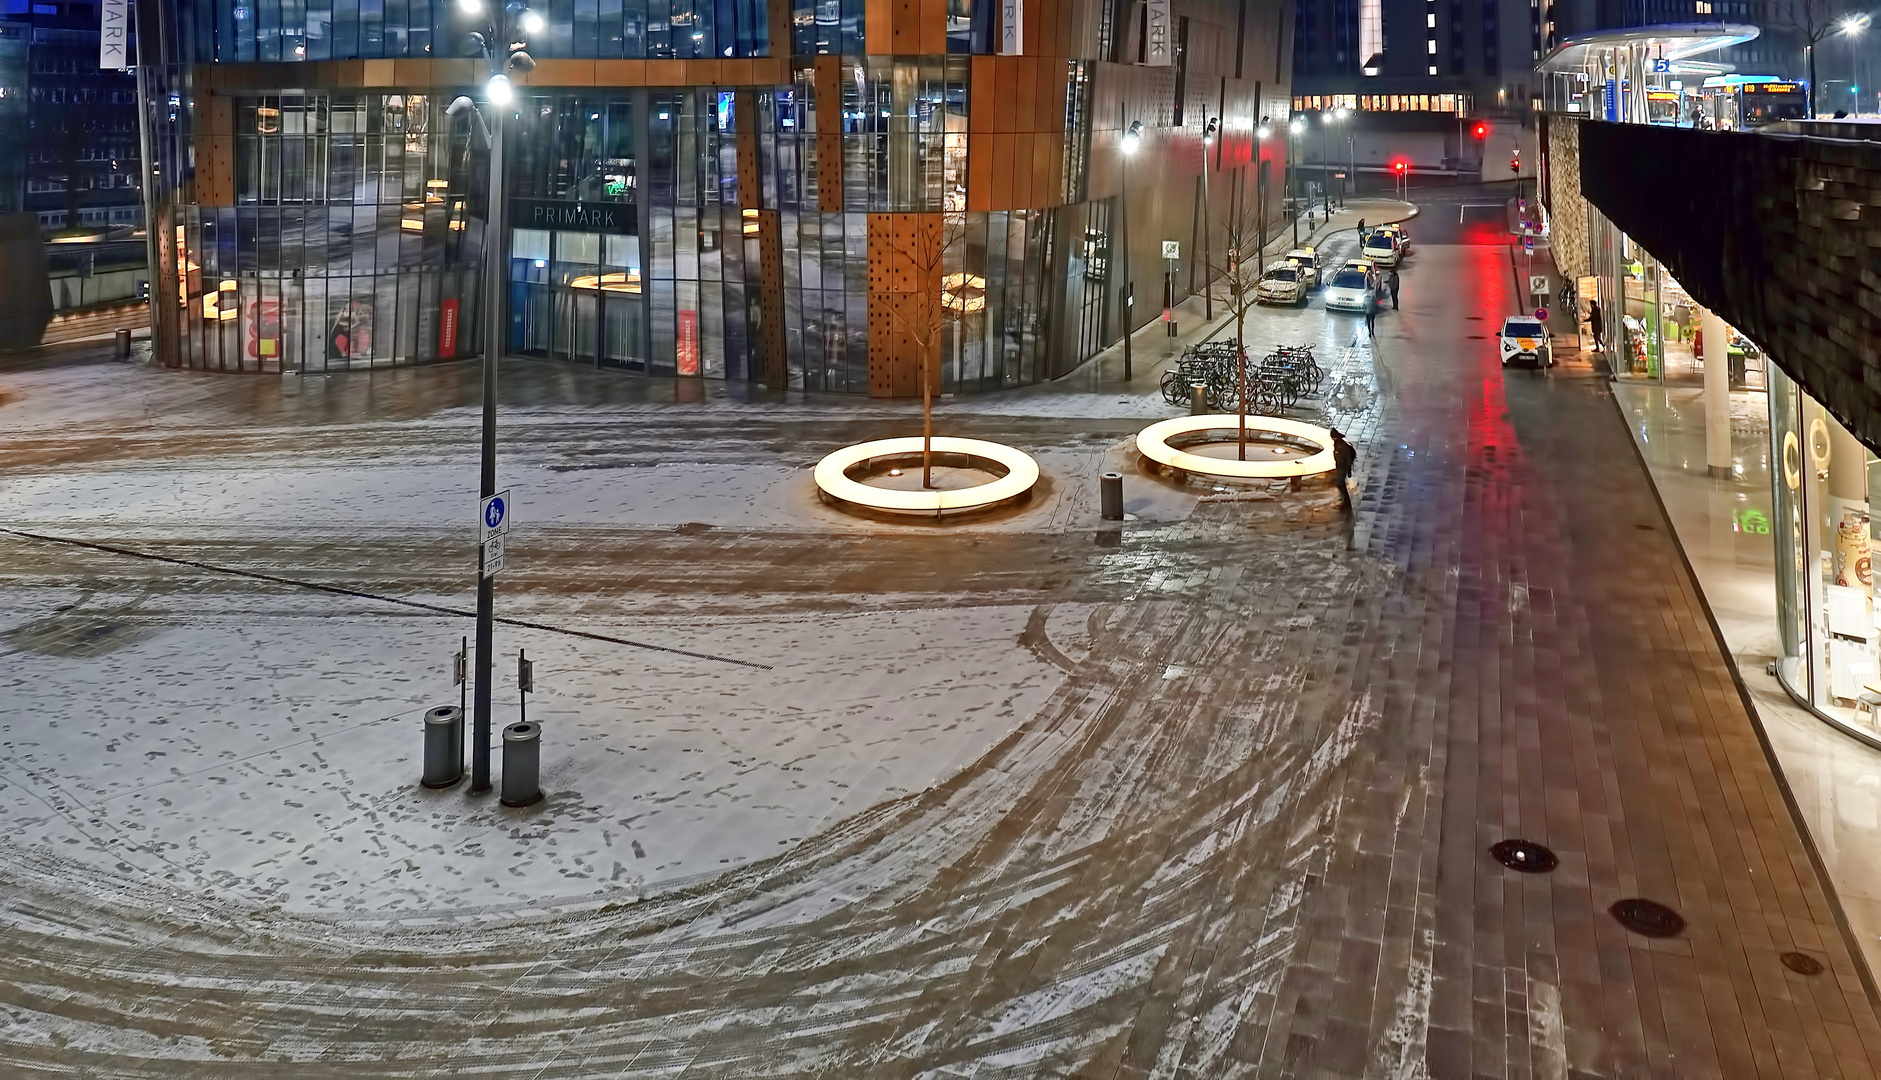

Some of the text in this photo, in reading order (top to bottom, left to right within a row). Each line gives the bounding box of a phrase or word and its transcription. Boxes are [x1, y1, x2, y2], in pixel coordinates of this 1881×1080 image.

[1657, 60, 1667, 72] 5
[534, 207, 615, 226] PRIMARK
[486, 525, 502, 538] ZONE
